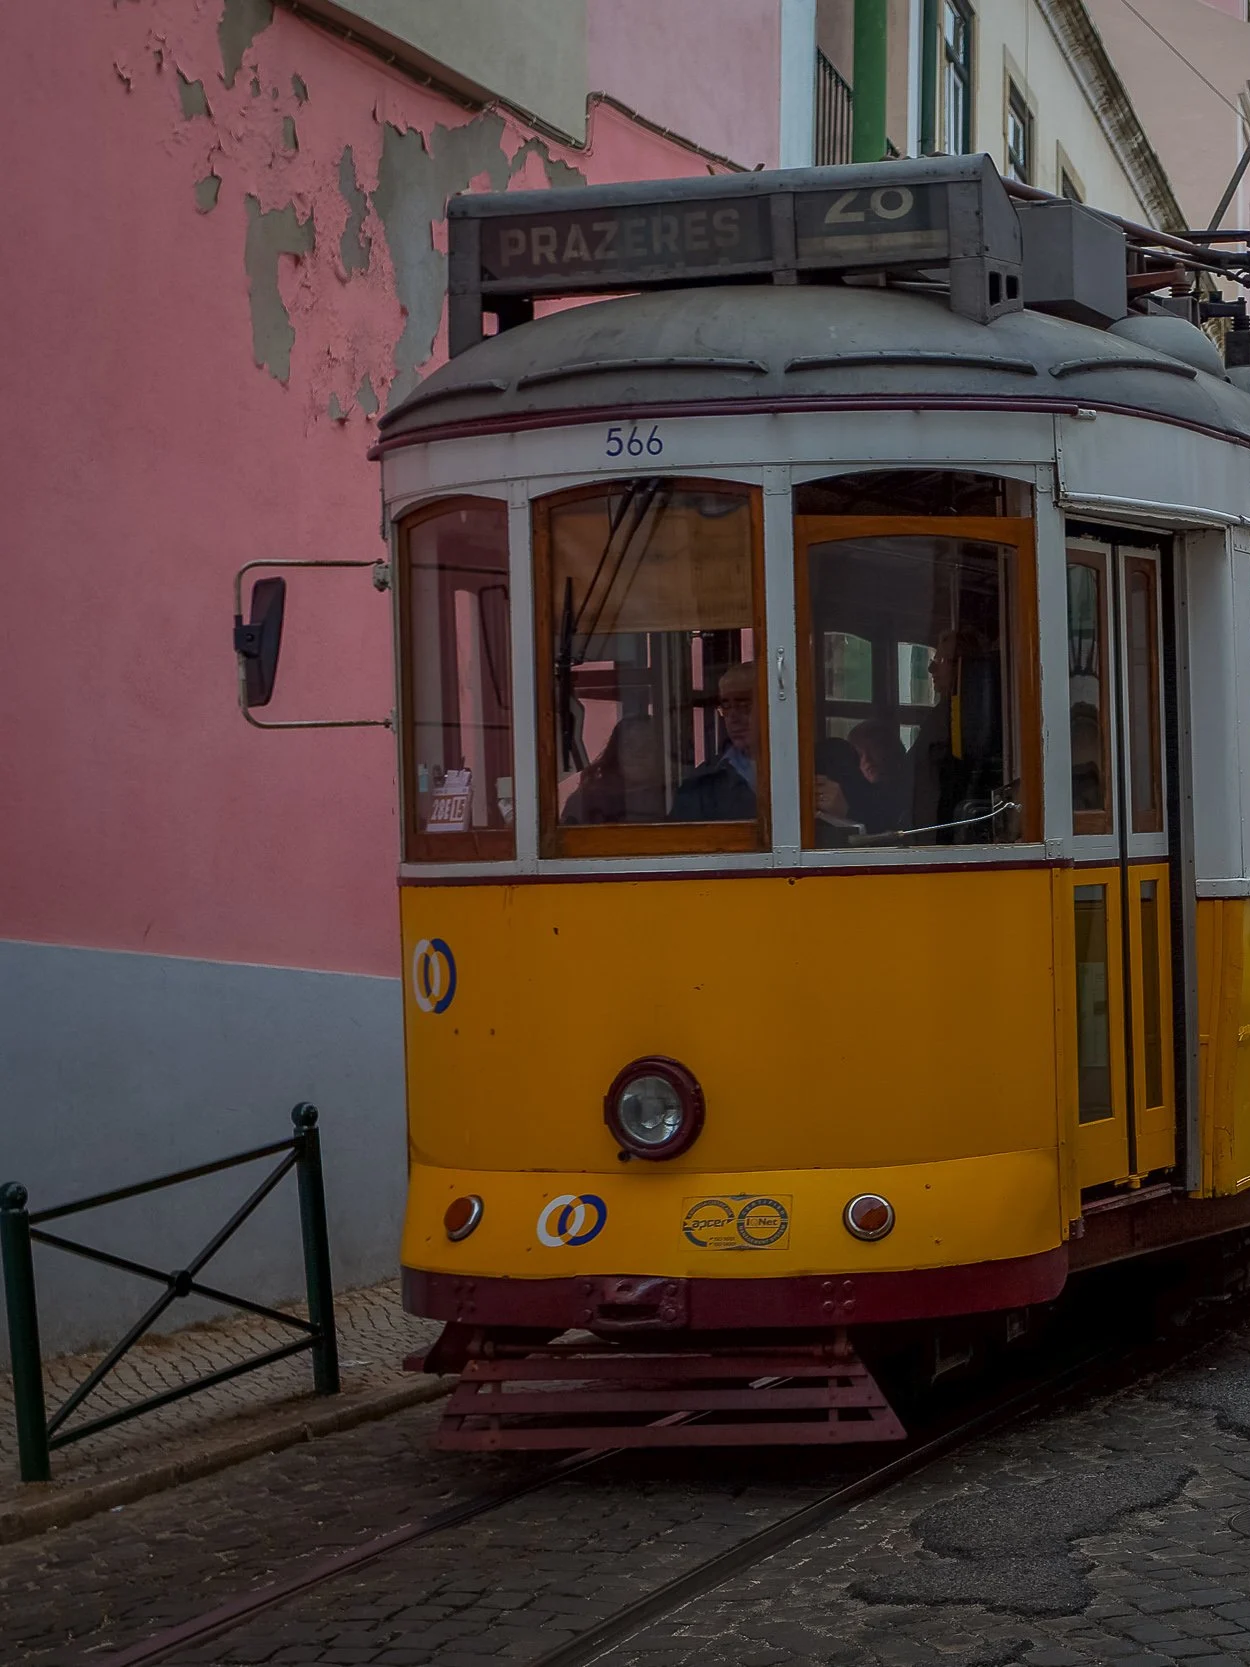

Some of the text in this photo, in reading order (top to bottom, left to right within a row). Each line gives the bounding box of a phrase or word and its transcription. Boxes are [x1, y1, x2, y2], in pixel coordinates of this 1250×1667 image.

[500, 208, 741, 267] PRAZERES
[606, 425, 663, 457] 566
[692, 1218, 728, 1230] apcer
